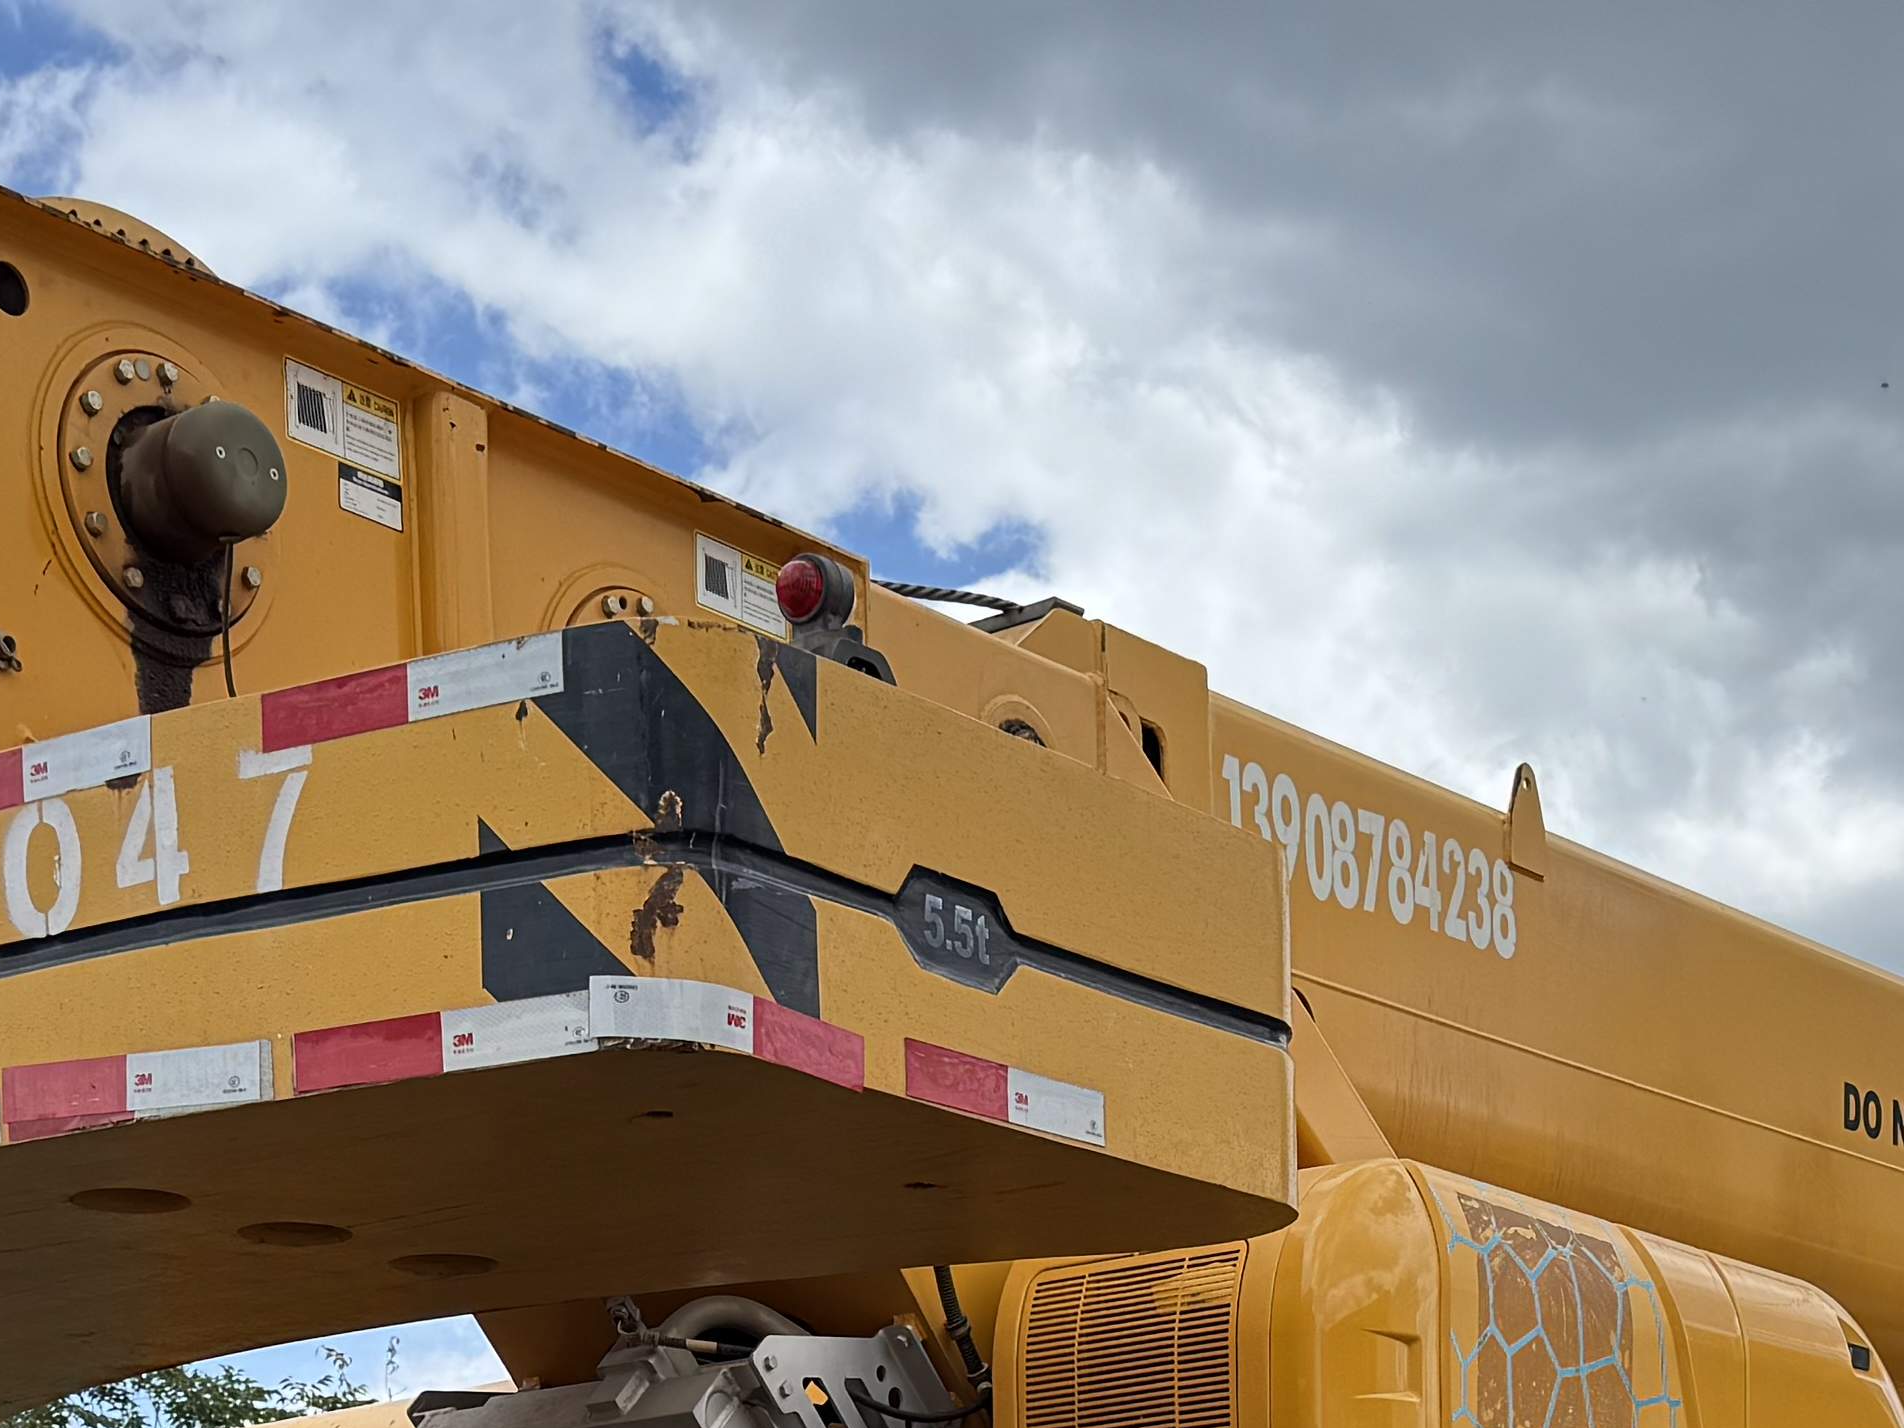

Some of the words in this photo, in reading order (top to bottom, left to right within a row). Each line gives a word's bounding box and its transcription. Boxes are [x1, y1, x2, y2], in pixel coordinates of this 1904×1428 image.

[418, 686, 439, 700] 3M
[30, 762, 48, 777] 3M
[1221, 753, 1517, 960] 13908784238
[923, 892, 991, 966] 5.5t
[453, 1033, 474, 1047] 3M
[135, 1073, 153, 1087] 3M
[1015, 1092, 1029, 1106] 3M
[1843, 1081, 1883, 1140] DO
